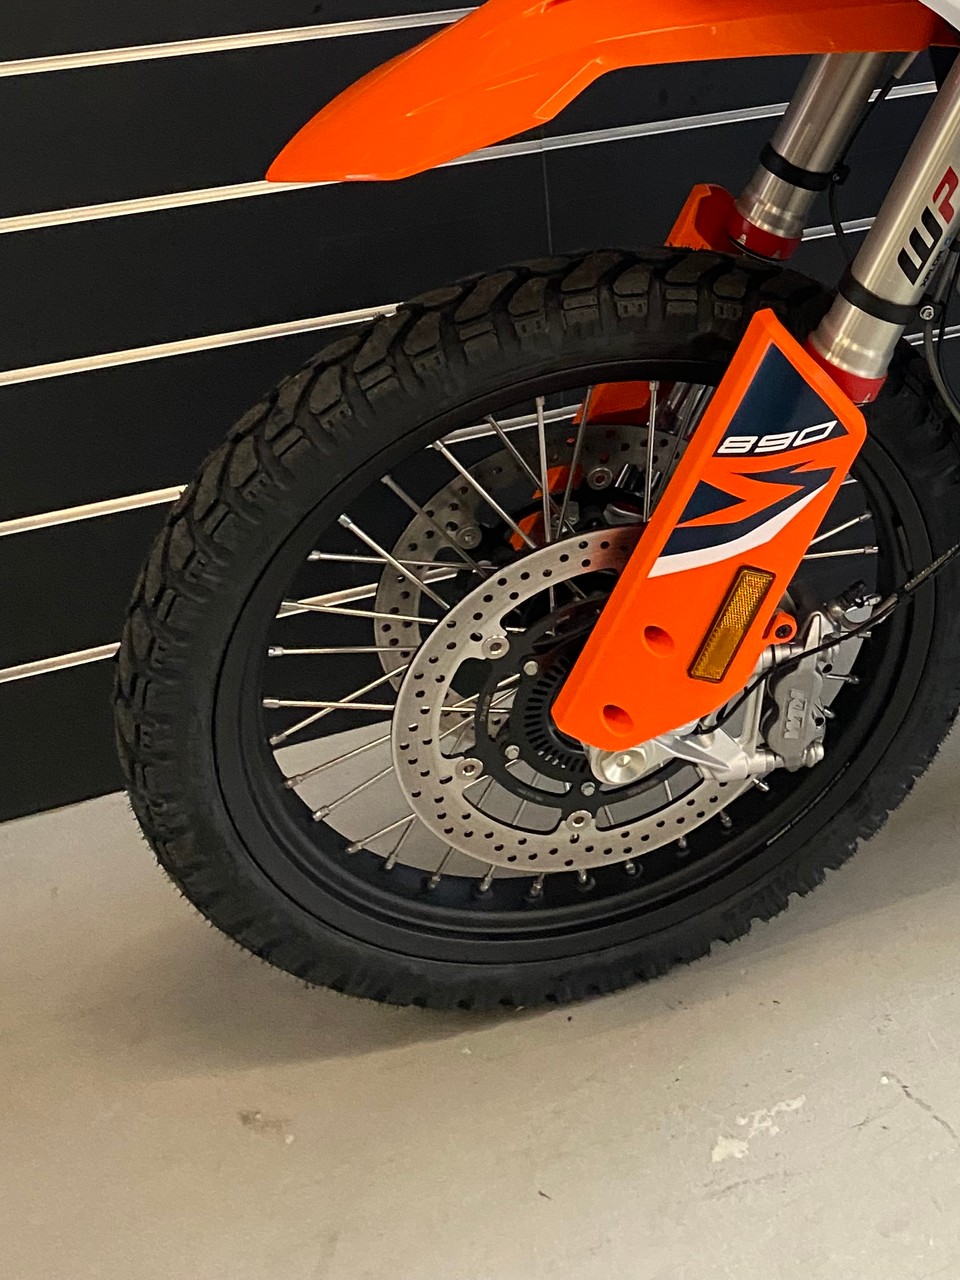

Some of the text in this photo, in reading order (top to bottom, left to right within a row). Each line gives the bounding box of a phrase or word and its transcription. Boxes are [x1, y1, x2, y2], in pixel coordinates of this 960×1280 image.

[897, 166, 959, 286] WP
[717, 420, 838, 453] 890
[783, 688, 807, 739] KTM
